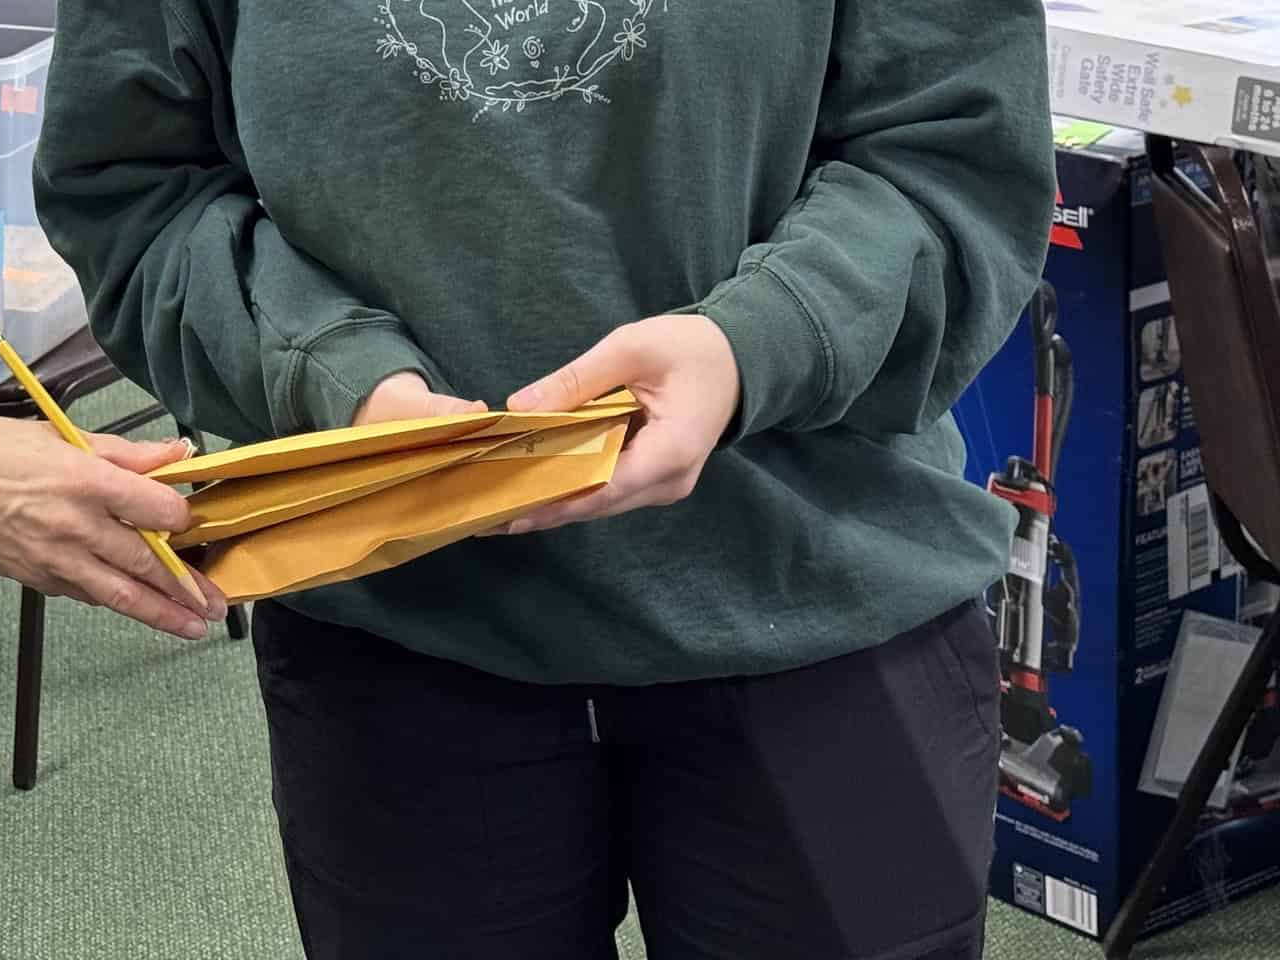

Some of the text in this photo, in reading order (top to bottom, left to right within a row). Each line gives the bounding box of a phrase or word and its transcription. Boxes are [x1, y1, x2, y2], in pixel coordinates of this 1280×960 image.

[1077, 57, 1094, 96] Gate
[1090, 55, 1111, 105] Safety
[1108, 64, 1126, 103] Wide
[1124, 64, 1142, 105] Extra
[1138, 52, 1160, 122] Wall Safe
